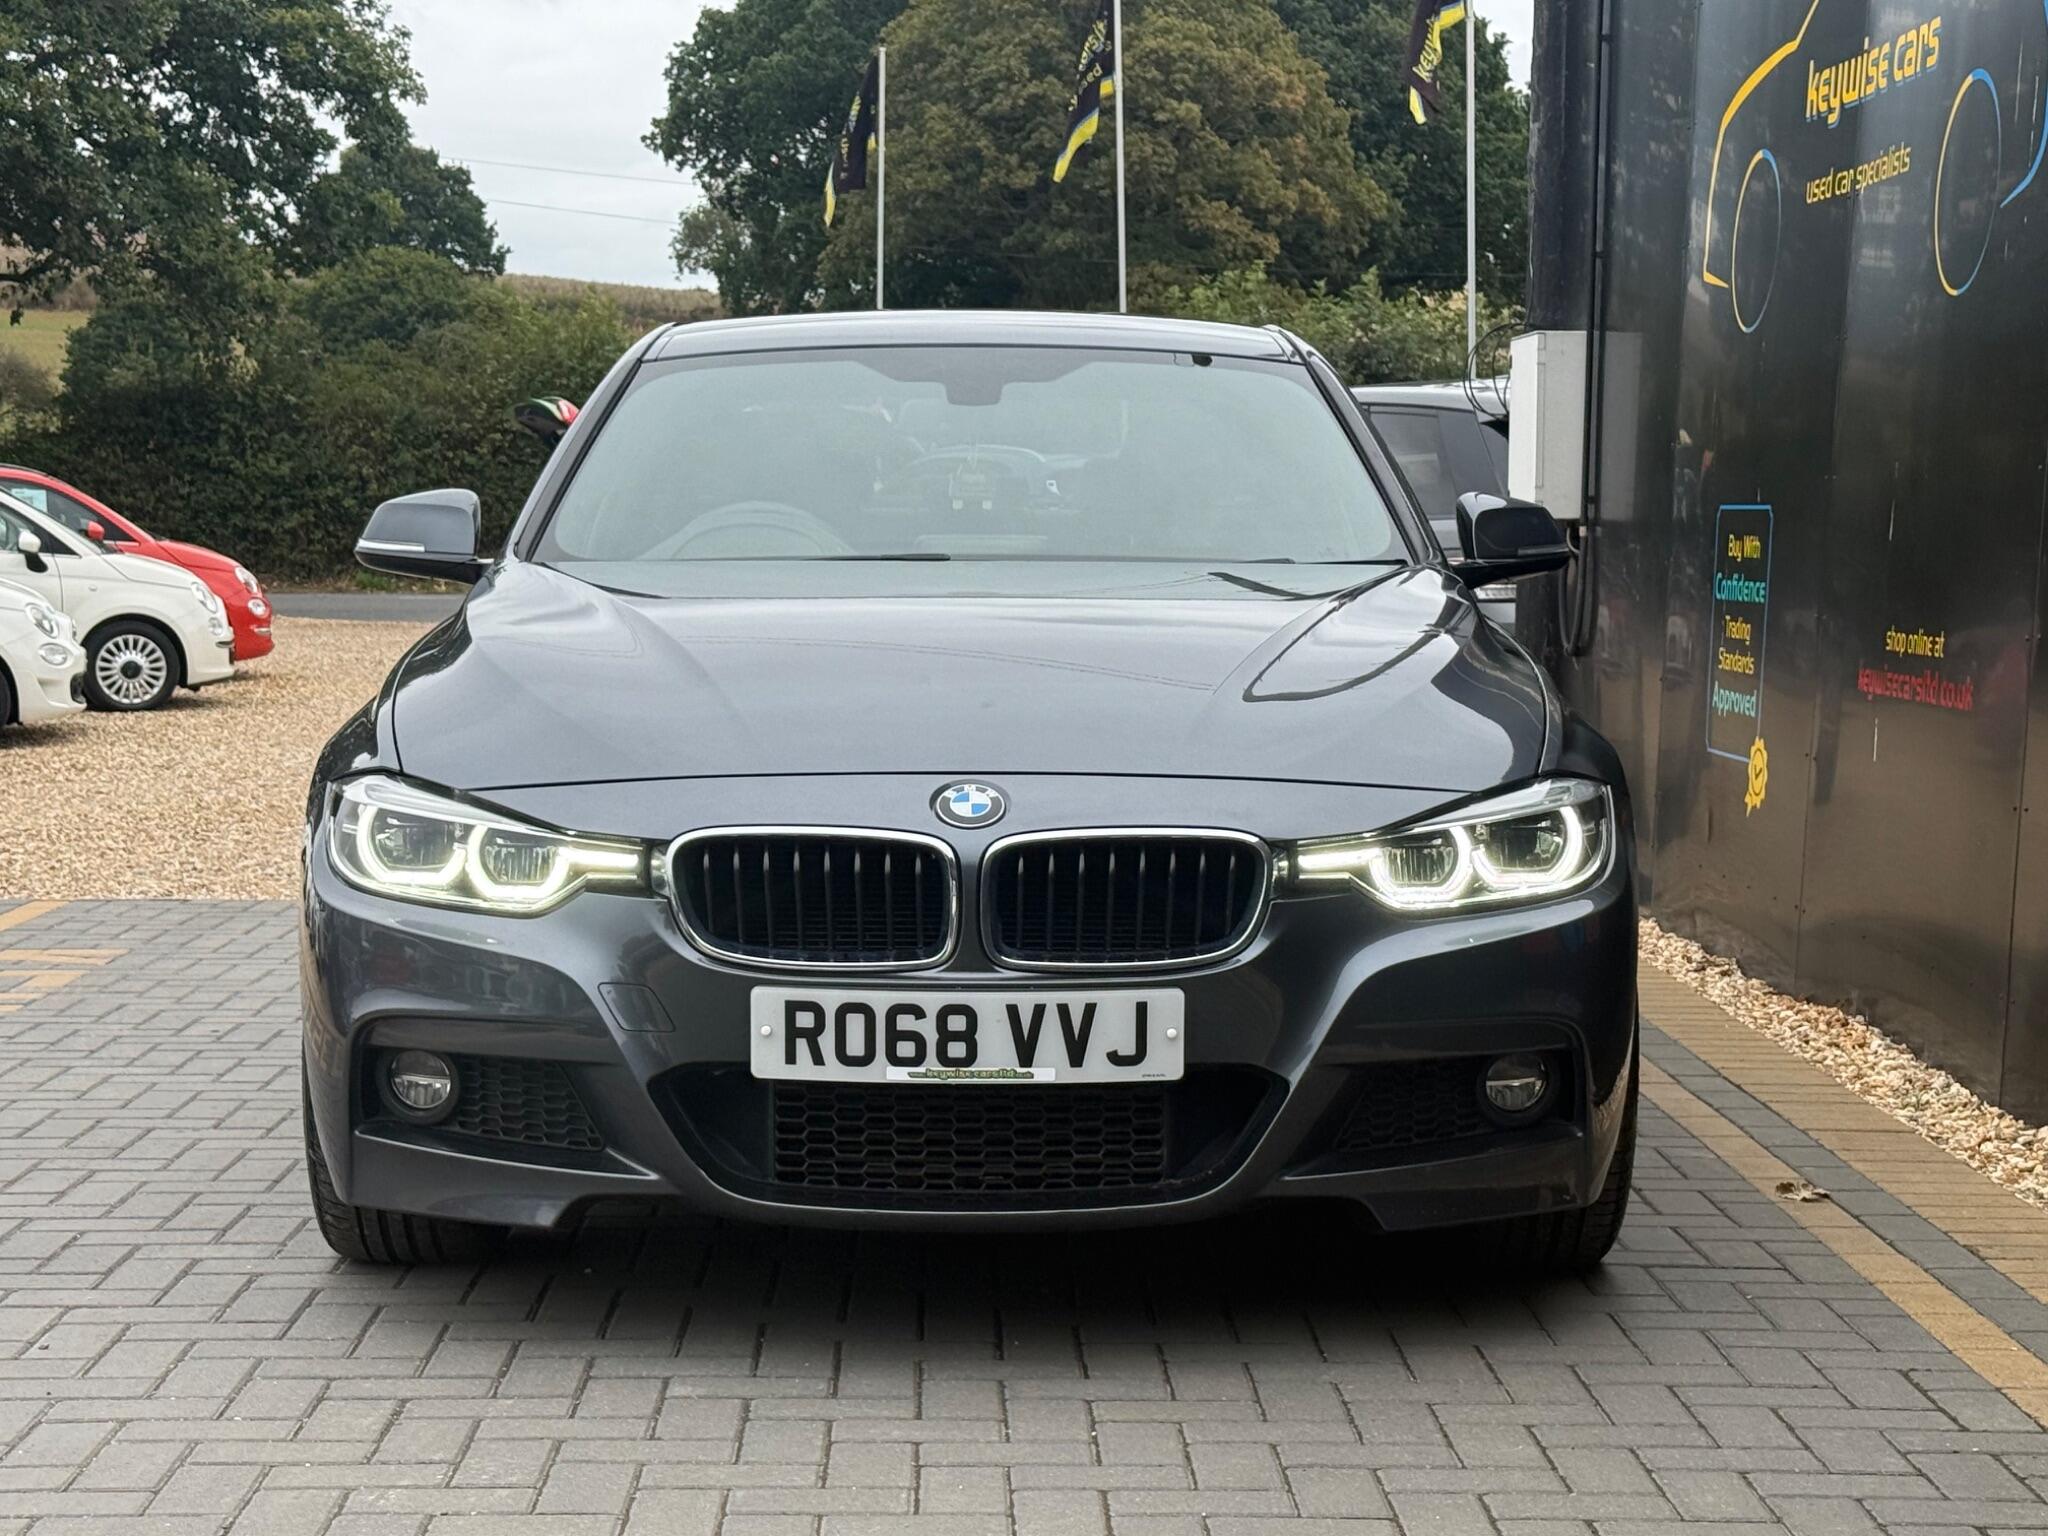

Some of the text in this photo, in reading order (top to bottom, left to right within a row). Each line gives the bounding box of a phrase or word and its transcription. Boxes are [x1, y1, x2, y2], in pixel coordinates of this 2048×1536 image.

[1805, 16, 1942, 128] keywise cars
[1806, 141, 1911, 204] used car specialists
[1728, 534, 1761, 562] Buy With
[1715, 572, 1766, 603] Confidence
[1725, 615, 1751, 646] Trading
[1885, 625, 1945, 659] shop online at
[1718, 647, 1754, 675] Standards
[1712, 680, 1757, 717] Approved
[784, 1000, 1148, 1068] RO68 VVJ
